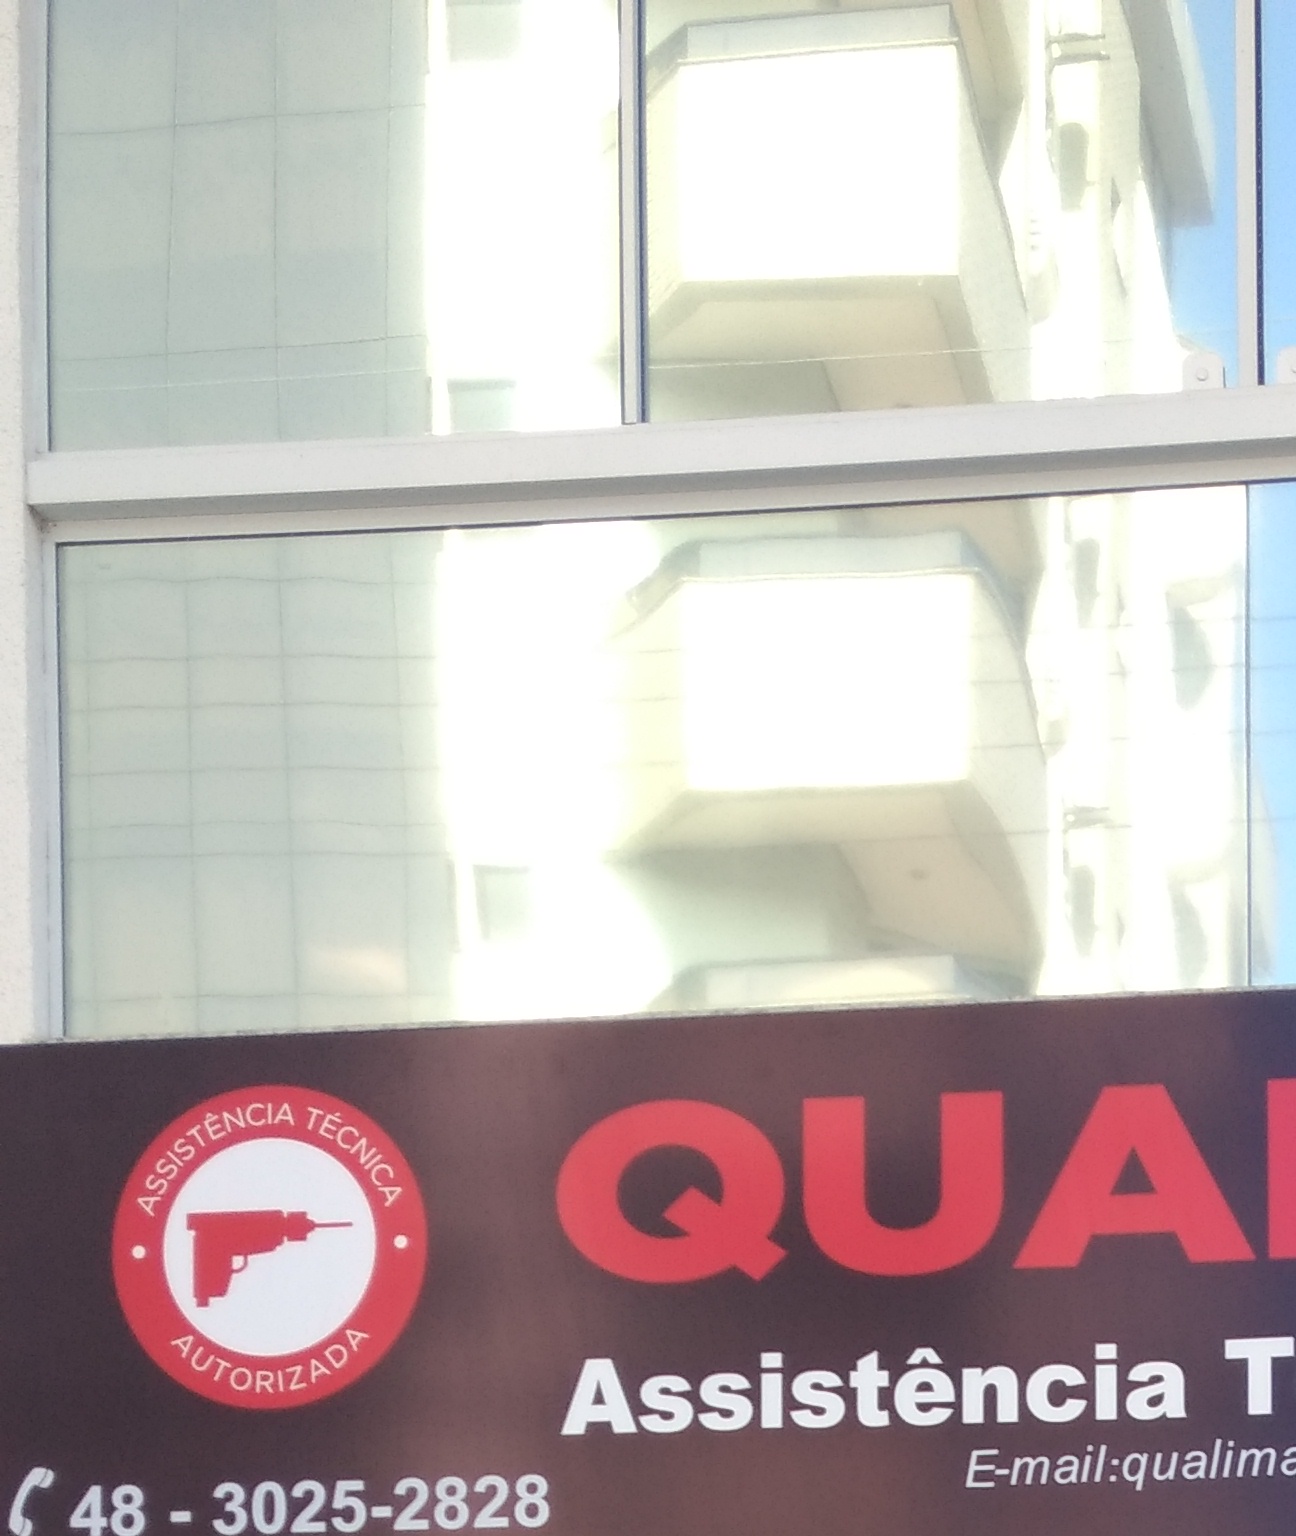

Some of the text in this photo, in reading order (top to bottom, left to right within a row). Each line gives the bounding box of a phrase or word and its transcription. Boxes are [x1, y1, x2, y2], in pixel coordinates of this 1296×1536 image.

[136, 1101, 404, 1217] ASSISTÊNCIA TÉCNICA
[170, 1323, 371, 1395] AUTORIZADA
[561, 1342, 1188, 1436] Assistência
[212, 1474, 551, 1535] 3025-2828
